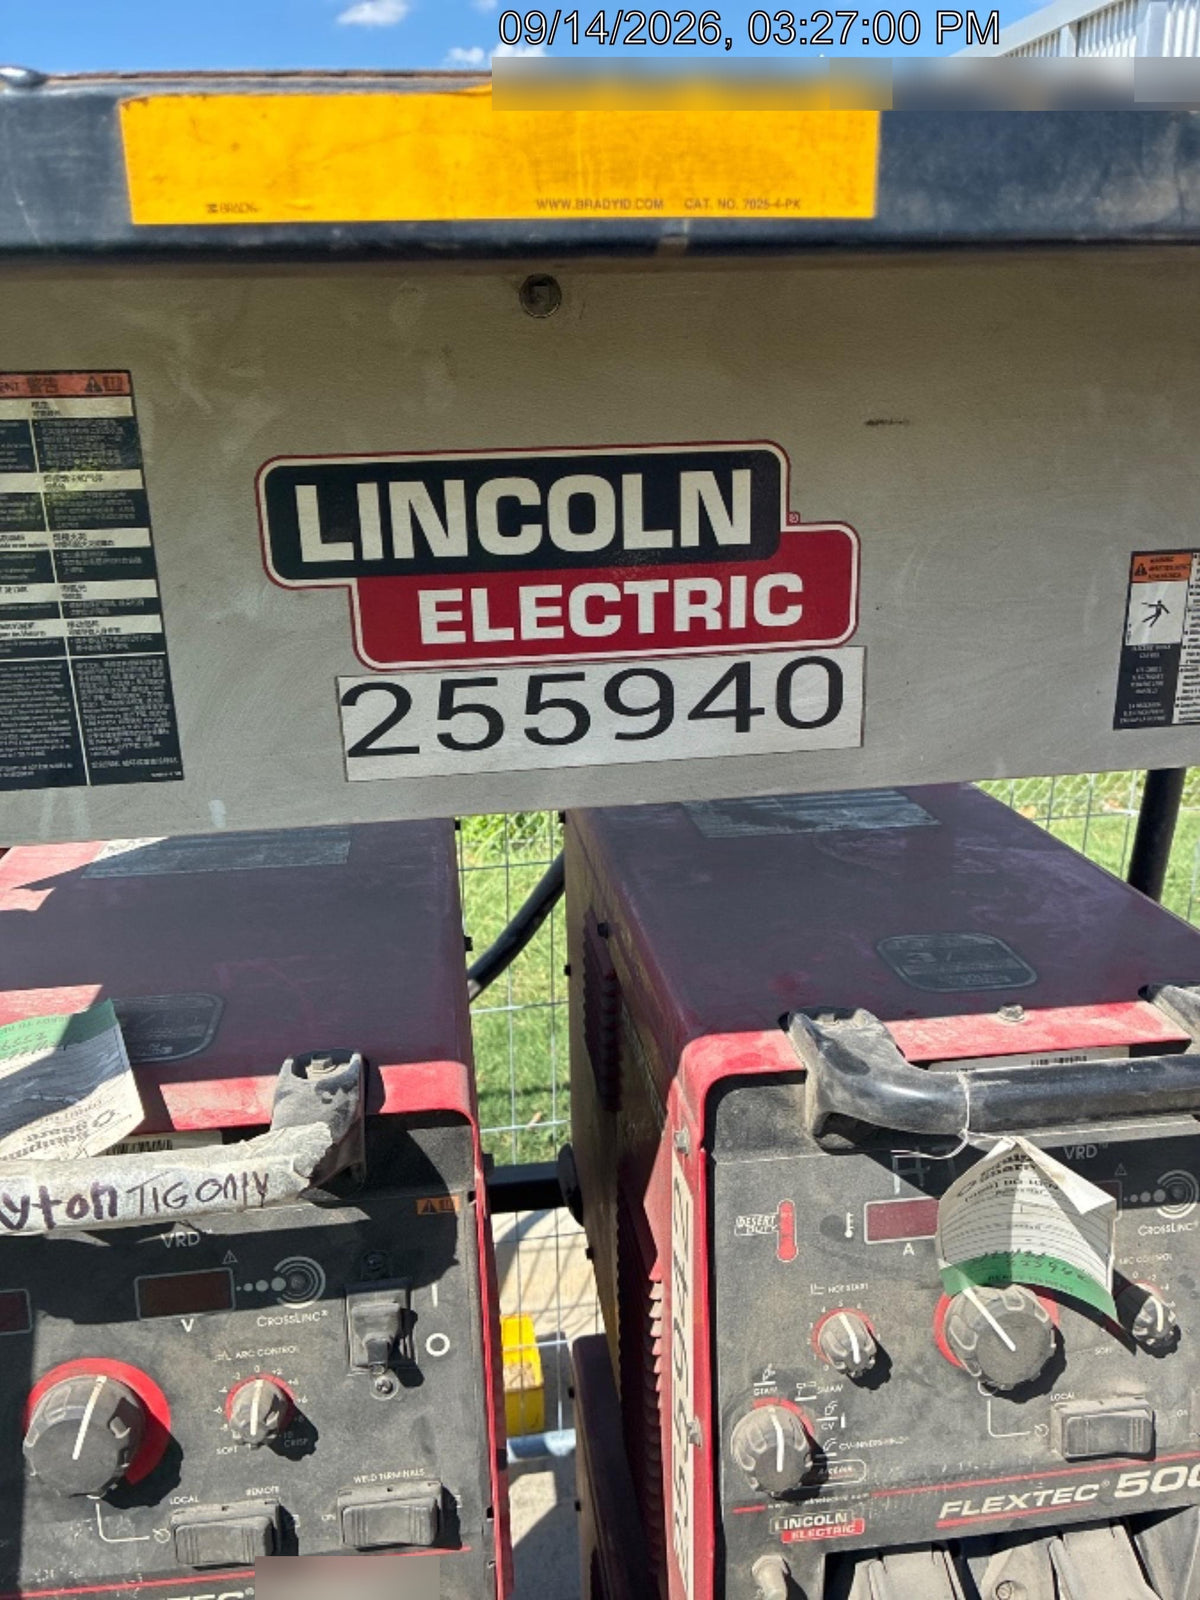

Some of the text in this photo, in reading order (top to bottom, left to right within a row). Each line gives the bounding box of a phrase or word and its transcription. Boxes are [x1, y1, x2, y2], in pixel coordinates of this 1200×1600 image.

[535, 198, 665, 211] WWW.BRADYID.COM
[684, 198, 711, 211] CAT.
[717, 198, 738, 211] NO.
[295, 468, 752, 563] LINCOLN
[418, 572, 804, 646] ELECTRIC
[340, 654, 845, 759] 255940
[126, 1170, 189, 1216] TIG
[902, 1242, 915, 1256] A
[180, 1318, 195, 1333] V
[169, 1494, 200, 1505] LOCAL
[775, 1512, 848, 1531] LINCOLN
[791, 1524, 856, 1540] ELECTRIC
